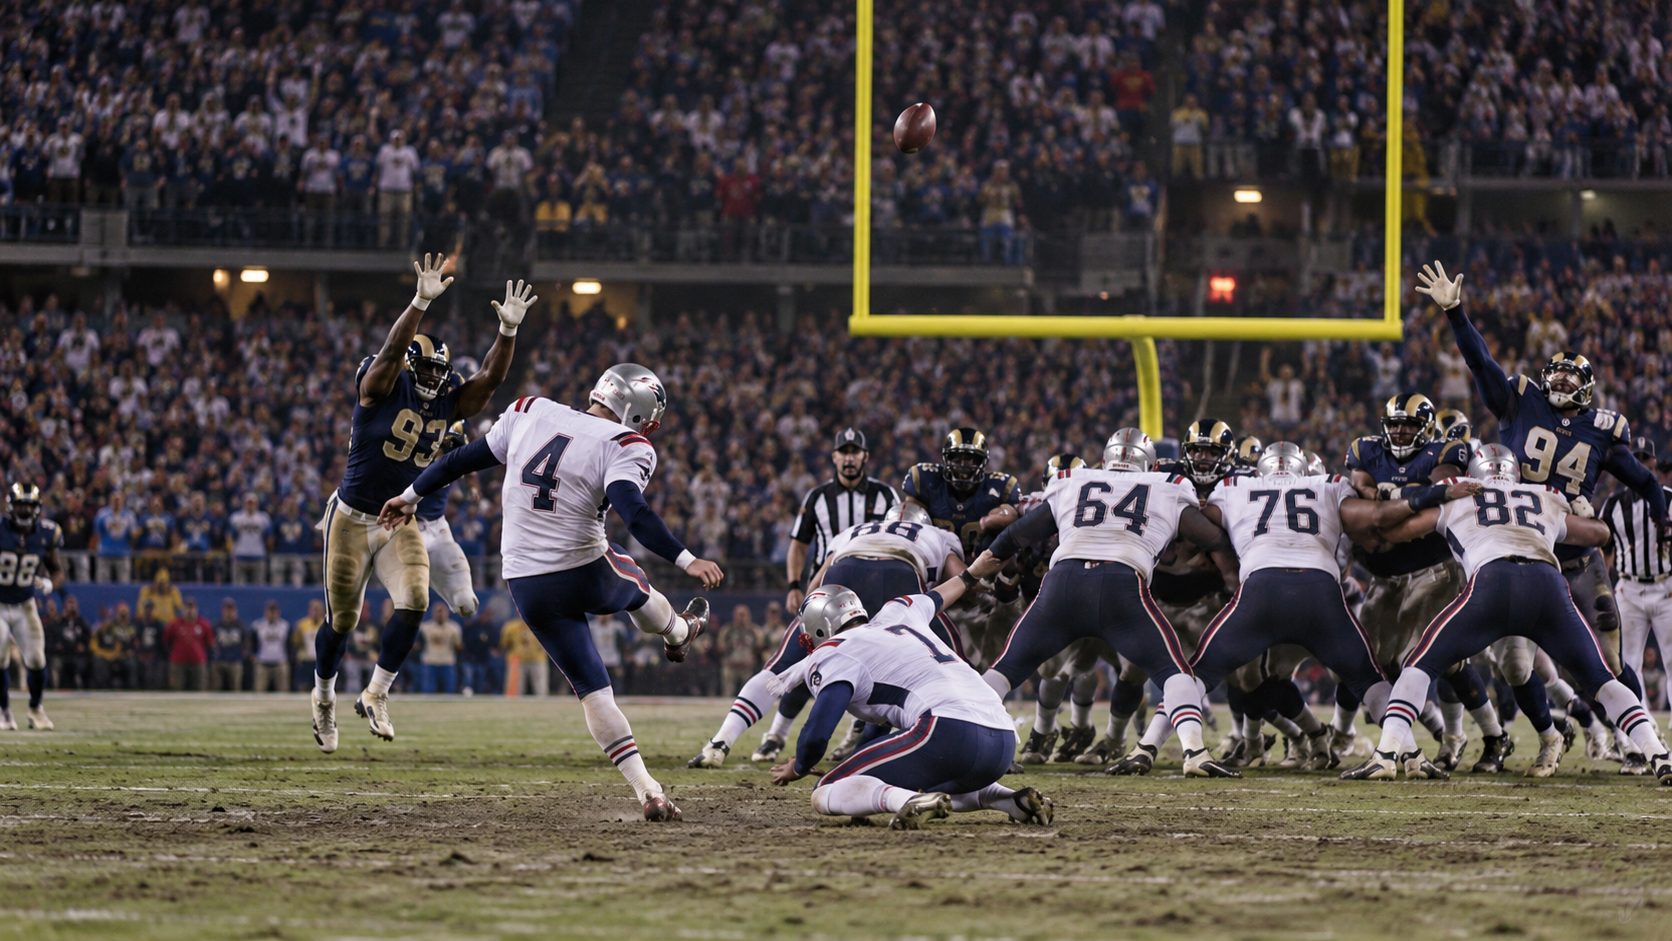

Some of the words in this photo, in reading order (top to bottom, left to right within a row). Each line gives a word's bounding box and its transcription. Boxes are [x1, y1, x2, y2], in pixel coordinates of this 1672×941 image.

[382, 408, 447, 468] 93
[1521, 425, 1592, 496] 94
[520, 432, 574, 514] 4
[1072, 481, 1151, 537] 64
[1247, 488, 1321, 539] 76
[1473, 487, 1546, 536] 82
[0, 551, 39, 587] 88
[884, 624, 959, 664] 7
